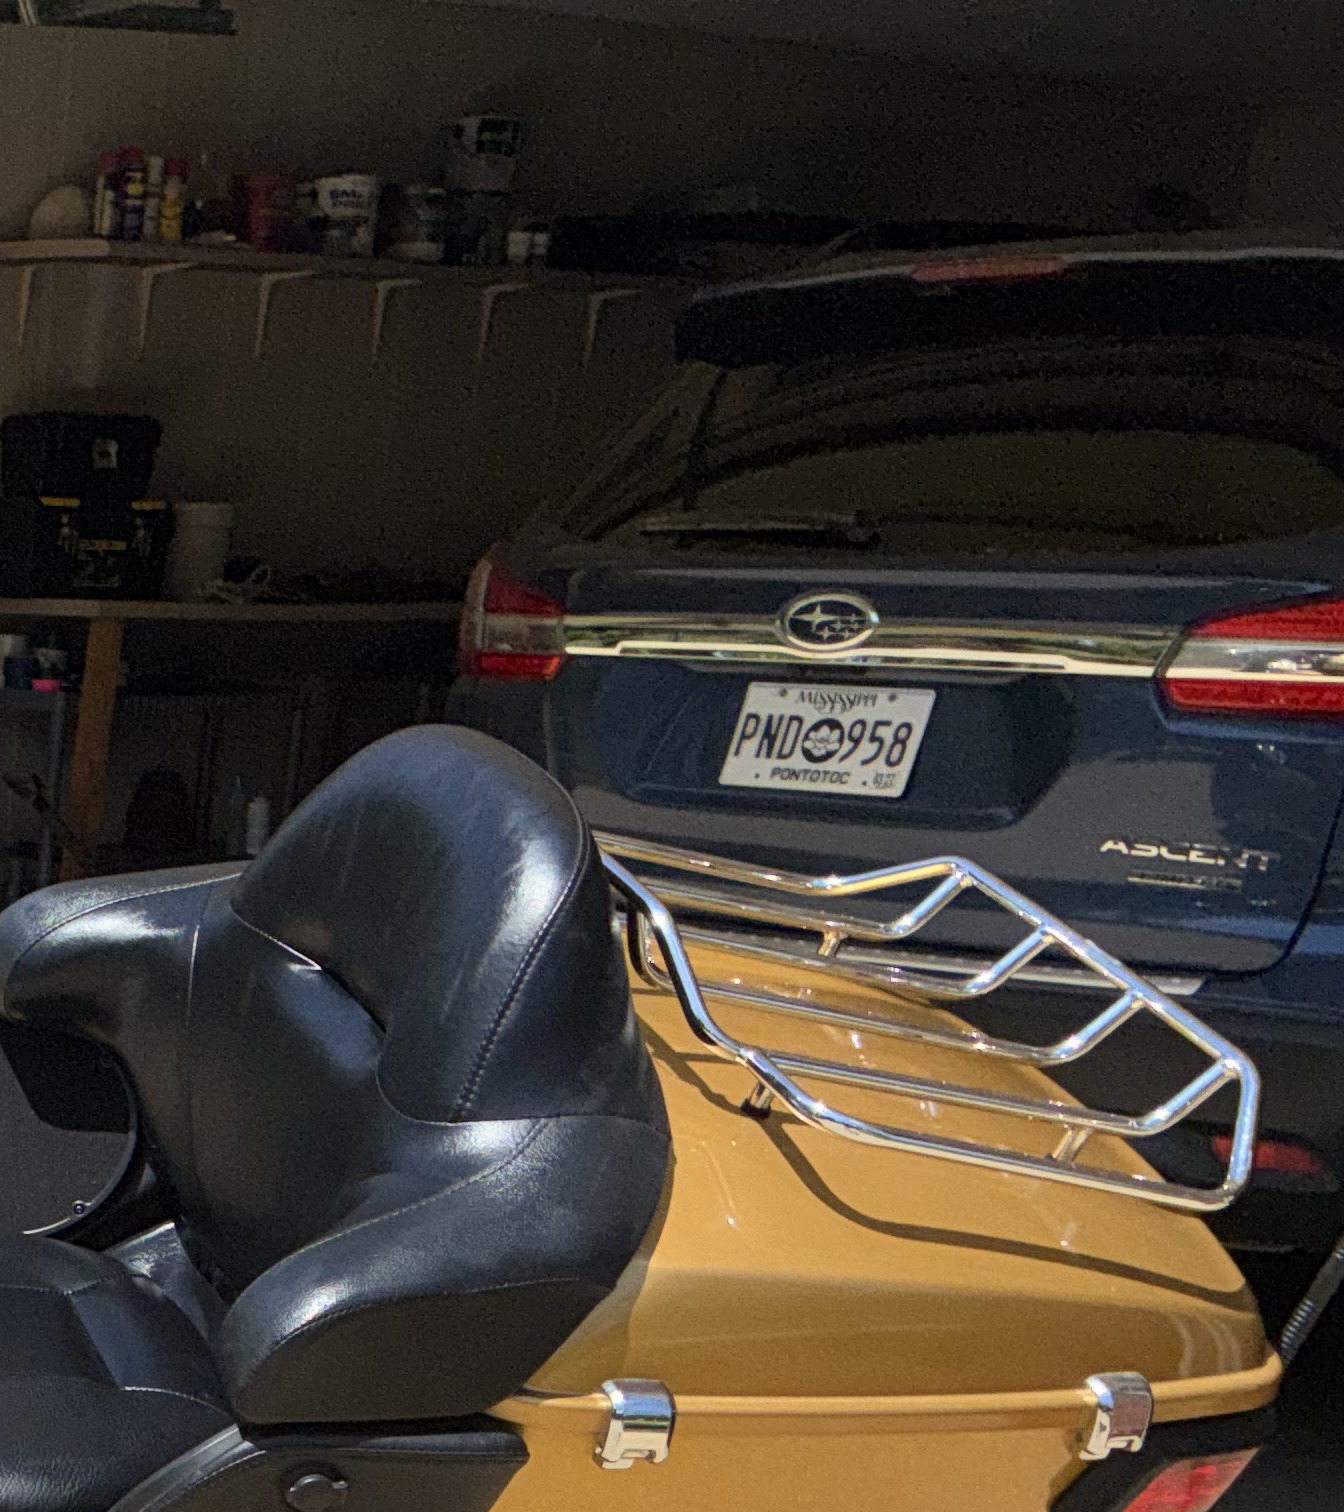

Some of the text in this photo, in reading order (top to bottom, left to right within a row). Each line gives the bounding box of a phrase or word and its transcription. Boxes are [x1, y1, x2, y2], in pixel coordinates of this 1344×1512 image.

[733, 712, 913, 767] PND 958
[770, 767, 852, 785] PONTOTOC
